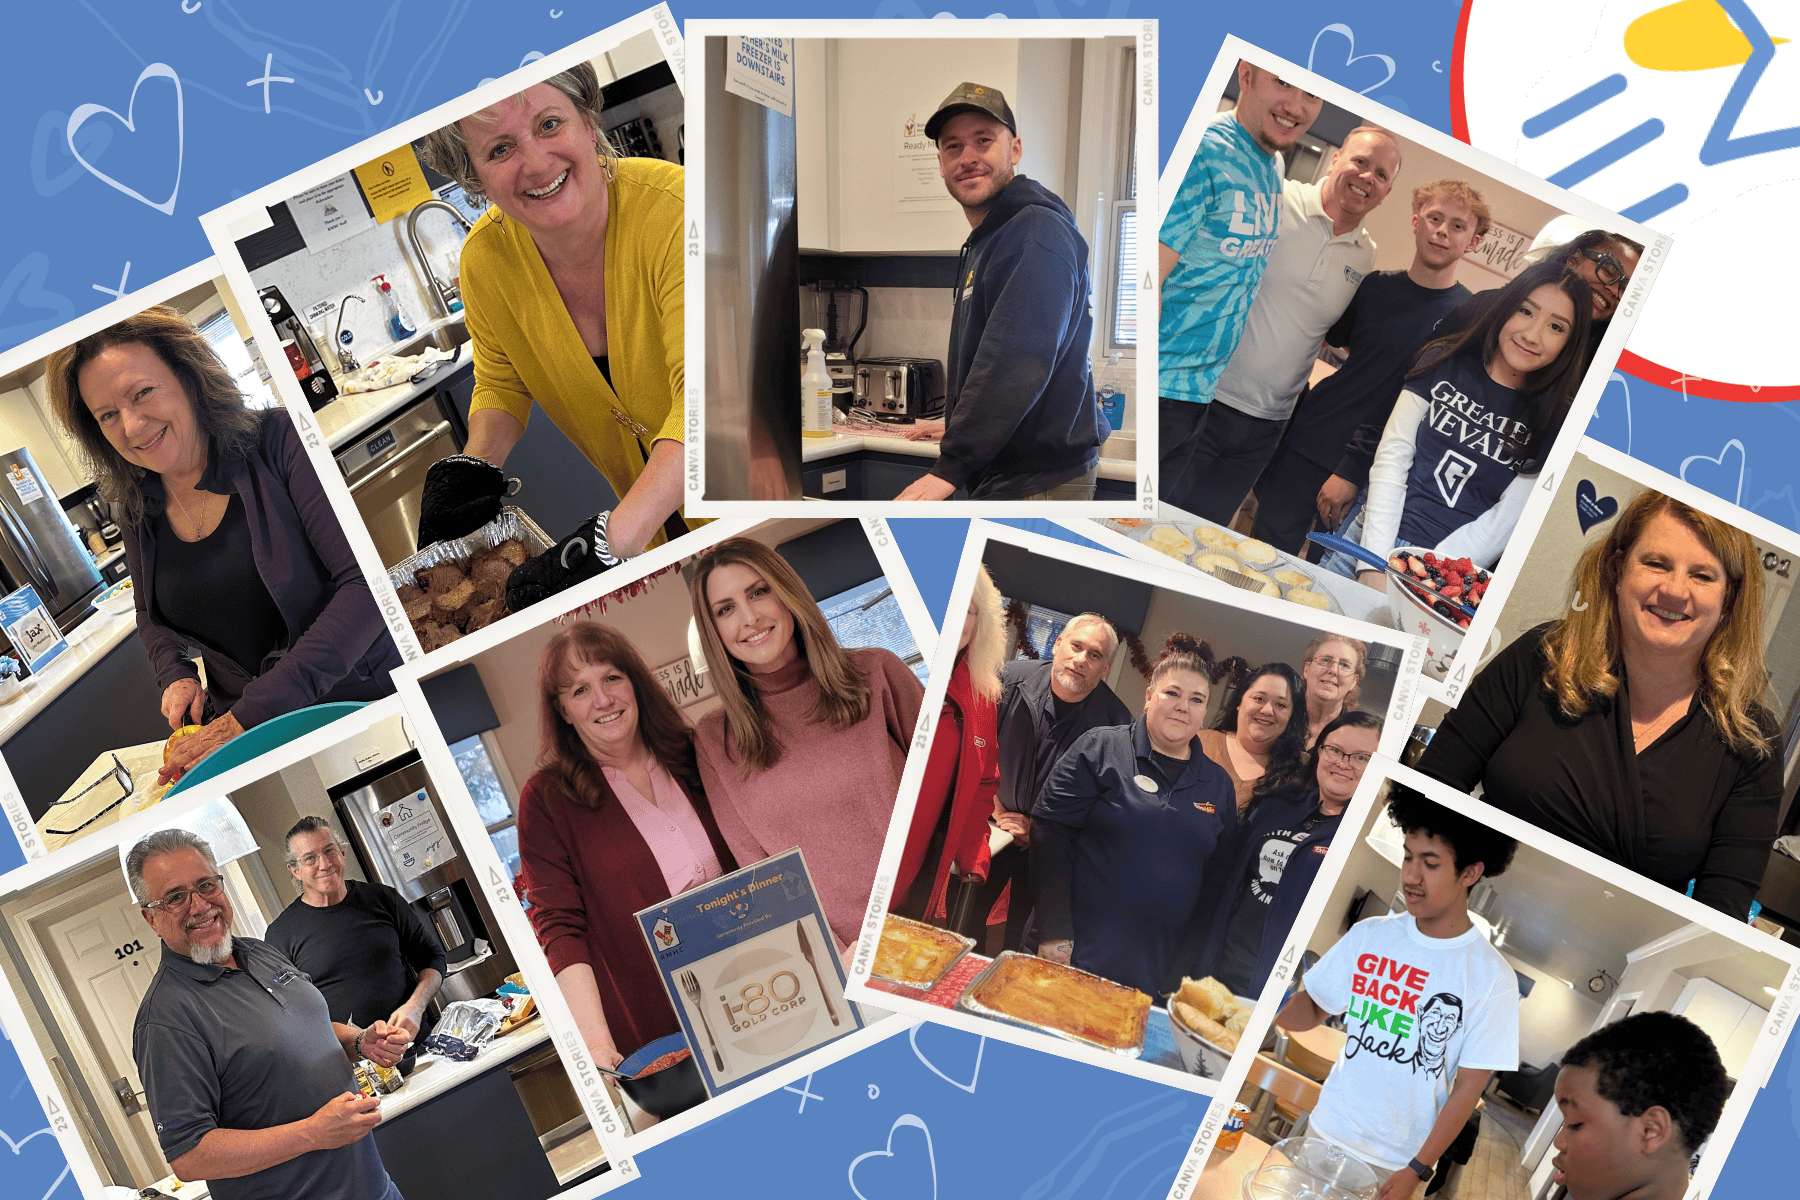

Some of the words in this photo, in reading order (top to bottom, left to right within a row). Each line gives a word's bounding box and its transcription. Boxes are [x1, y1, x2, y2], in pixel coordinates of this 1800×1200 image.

[741, 42, 772, 67] FREEZER
[774, 60, 781, 71] IS
[771, 46, 788, 64] MILK
[736, 52, 786, 86] DOWNSTAIRS
[904, 141, 926, 150] Ready
[1507, 233, 1516, 244] IS
[370, 434, 391, 452] CLEAN
[446, 457, 481, 465] Cuisinart
[1757, 547, 1791, 579] 01
[25, 623, 44, 643] jax
[673, 664, 683, 675] IS
[393, 825, 418, 839] Community
[1272, 849, 1285, 858] Ask
[696, 888, 747, 914] Tonight's
[747, 873, 783, 893] Dinner
[114, 938, 144, 961] 101
[660, 947, 685, 961] RMHC
[1356, 952, 1430, 992] GIVE
[719, 970, 801, 1026] i-80
[1351, 973, 1422, 1015] BACK
[732, 1013, 767, 1033] GOLD
[772, 996, 806, 1017] CORP
[1348, 995, 1414, 1040] LIKE
[1344, 1021, 1421, 1064] Jack
